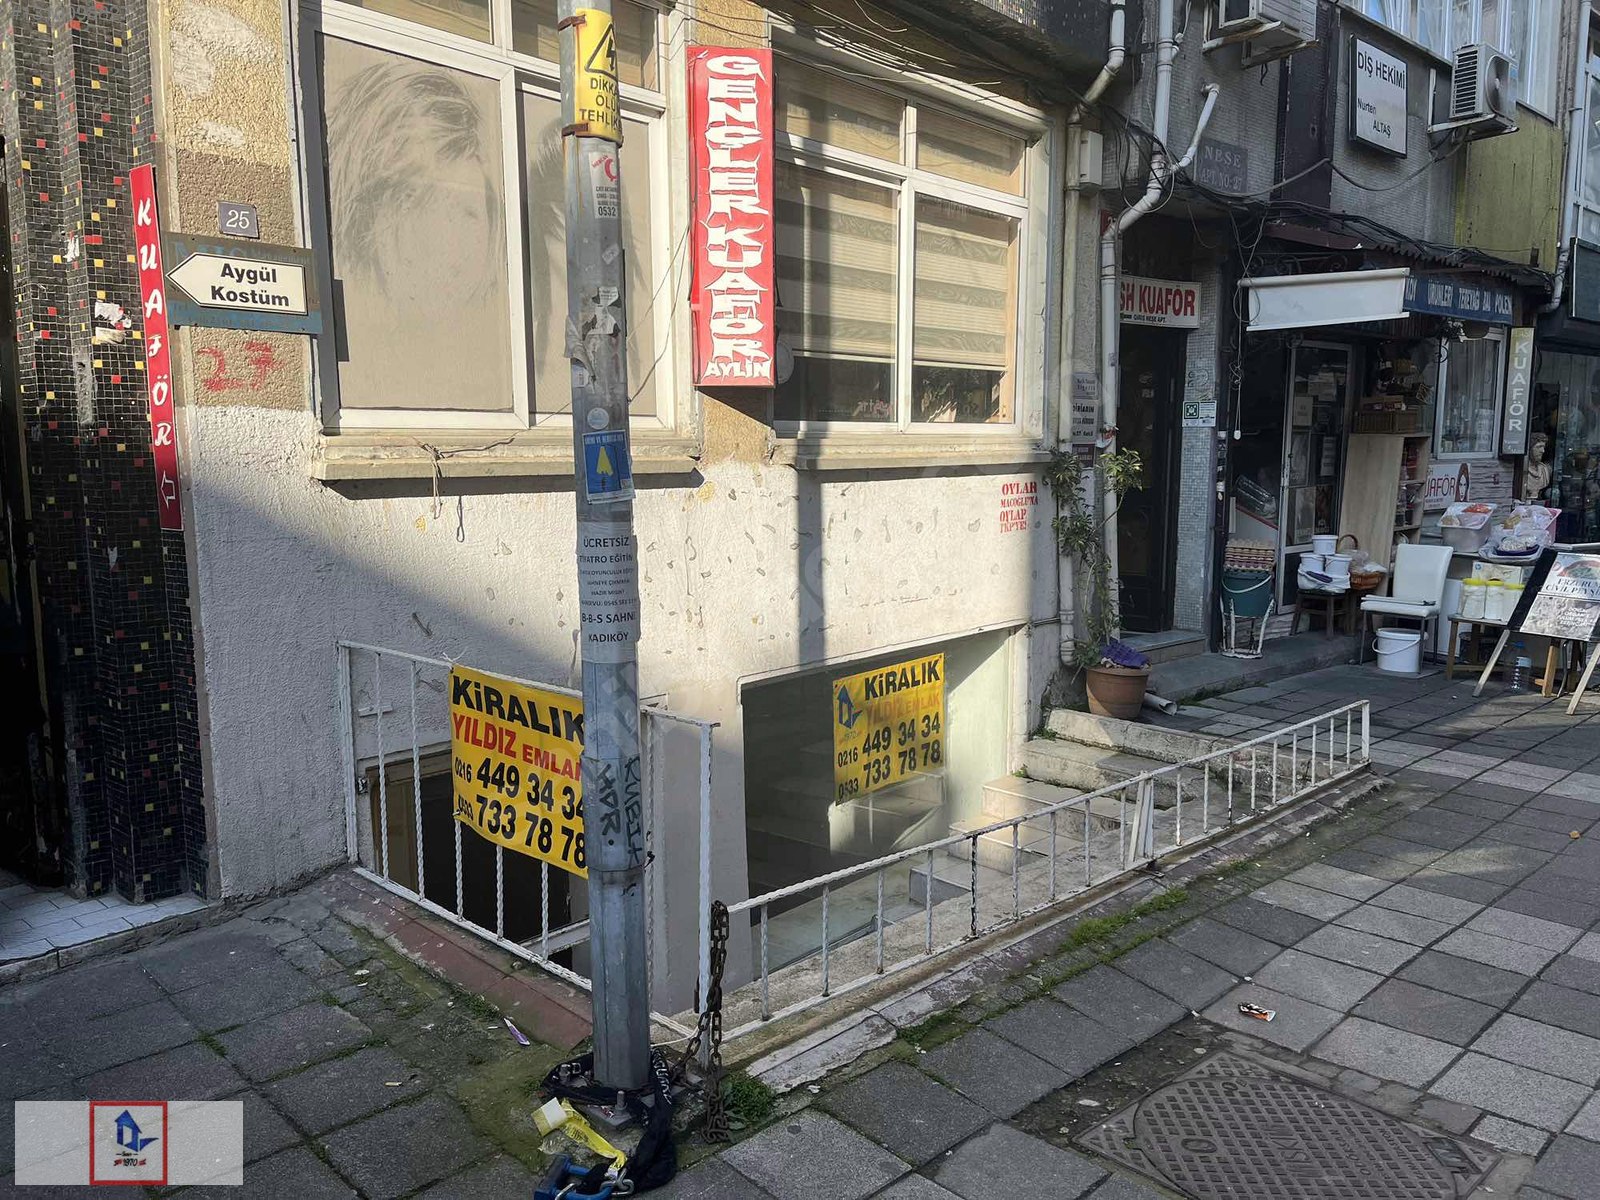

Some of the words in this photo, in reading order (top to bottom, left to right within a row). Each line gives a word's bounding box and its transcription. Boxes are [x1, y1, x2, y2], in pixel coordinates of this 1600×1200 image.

[1358, 51, 1373, 78] DİŞ
[1376, 60, 1405, 90] HEKİMİ
[596, 91, 619, 111] ÖLÜ
[1358, 98, 1377, 115] Nurten
[702, 54, 769, 222] GENÇLER
[1373, 120, 1391, 138] ALTAŞ
[226, 209, 250, 229] 25
[598, 206, 616, 216] 0532
[220, 263, 277, 285] Aygül
[699, 218, 768, 364] KUAFÖR
[210, 285, 290, 307] Kostüm
[1139, 285, 1195, 317] KUAFÖR
[136, 198, 172, 447] KUAFÖR
[197, 341, 281, 393] 27
[701, 357, 773, 381] AYLİN
[1508, 341, 1530, 432] KUAFÖR
[583, 535, 630, 548] ÜCRETSİZ
[588, 630, 629, 643] KADIKÖY
[453, 713, 517, 759] YILDIZ
[838, 747, 858, 768] 0216
[862, 726, 891, 757] 449
[898, 718, 916, 747] 34
[921, 712, 940, 738] 34
[863, 755, 891, 788] 733
[898, 747, 917, 775] 78
[921, 739, 941, 766] 78
[455, 757, 472, 783] 0216
[477, 757, 520, 799] 449
[527, 772, 554, 812] 34
[476, 794, 517, 840] 733
[525, 812, 553, 854] 78
[561, 826, 585, 869] 78
